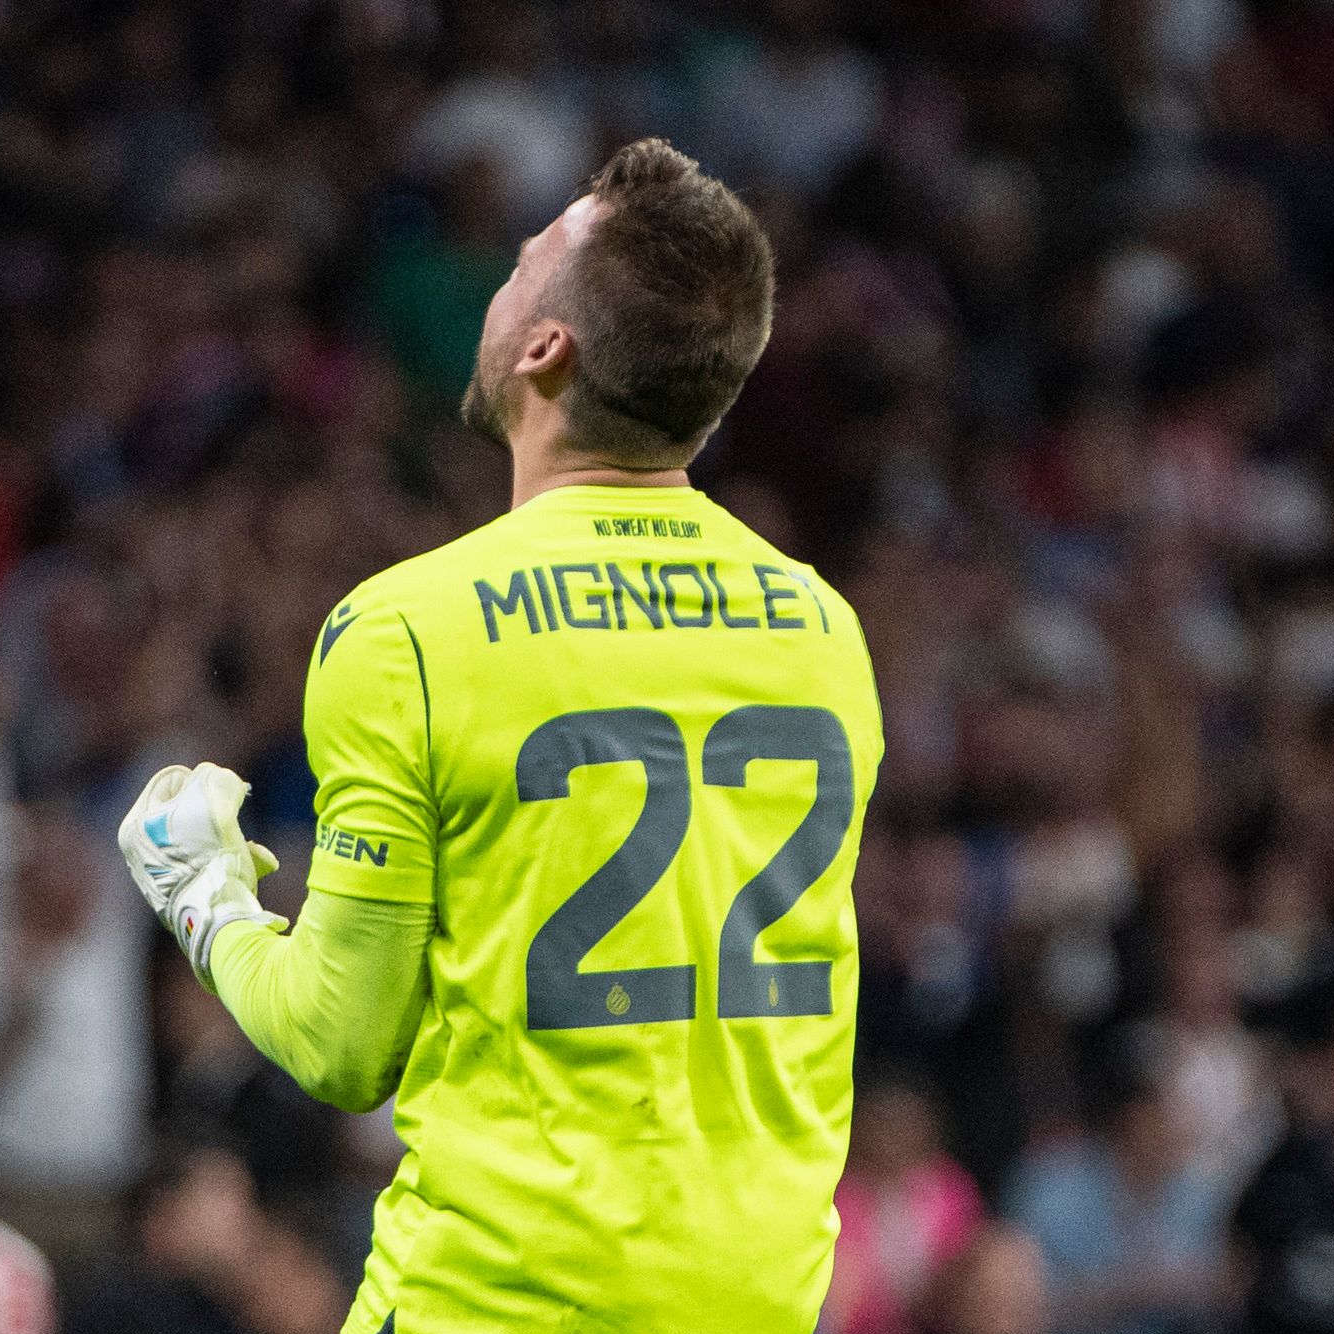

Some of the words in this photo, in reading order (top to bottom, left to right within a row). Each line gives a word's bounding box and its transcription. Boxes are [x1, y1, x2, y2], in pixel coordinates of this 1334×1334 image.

[593, 518, 612, 537] NO
[612, 518, 650, 537] SWEAT
[651, 518, 668, 537] NO
[668, 519, 703, 539] GLORY
[316, 823, 389, 868] EVEN
[515, 704, 856, 1030] 22
